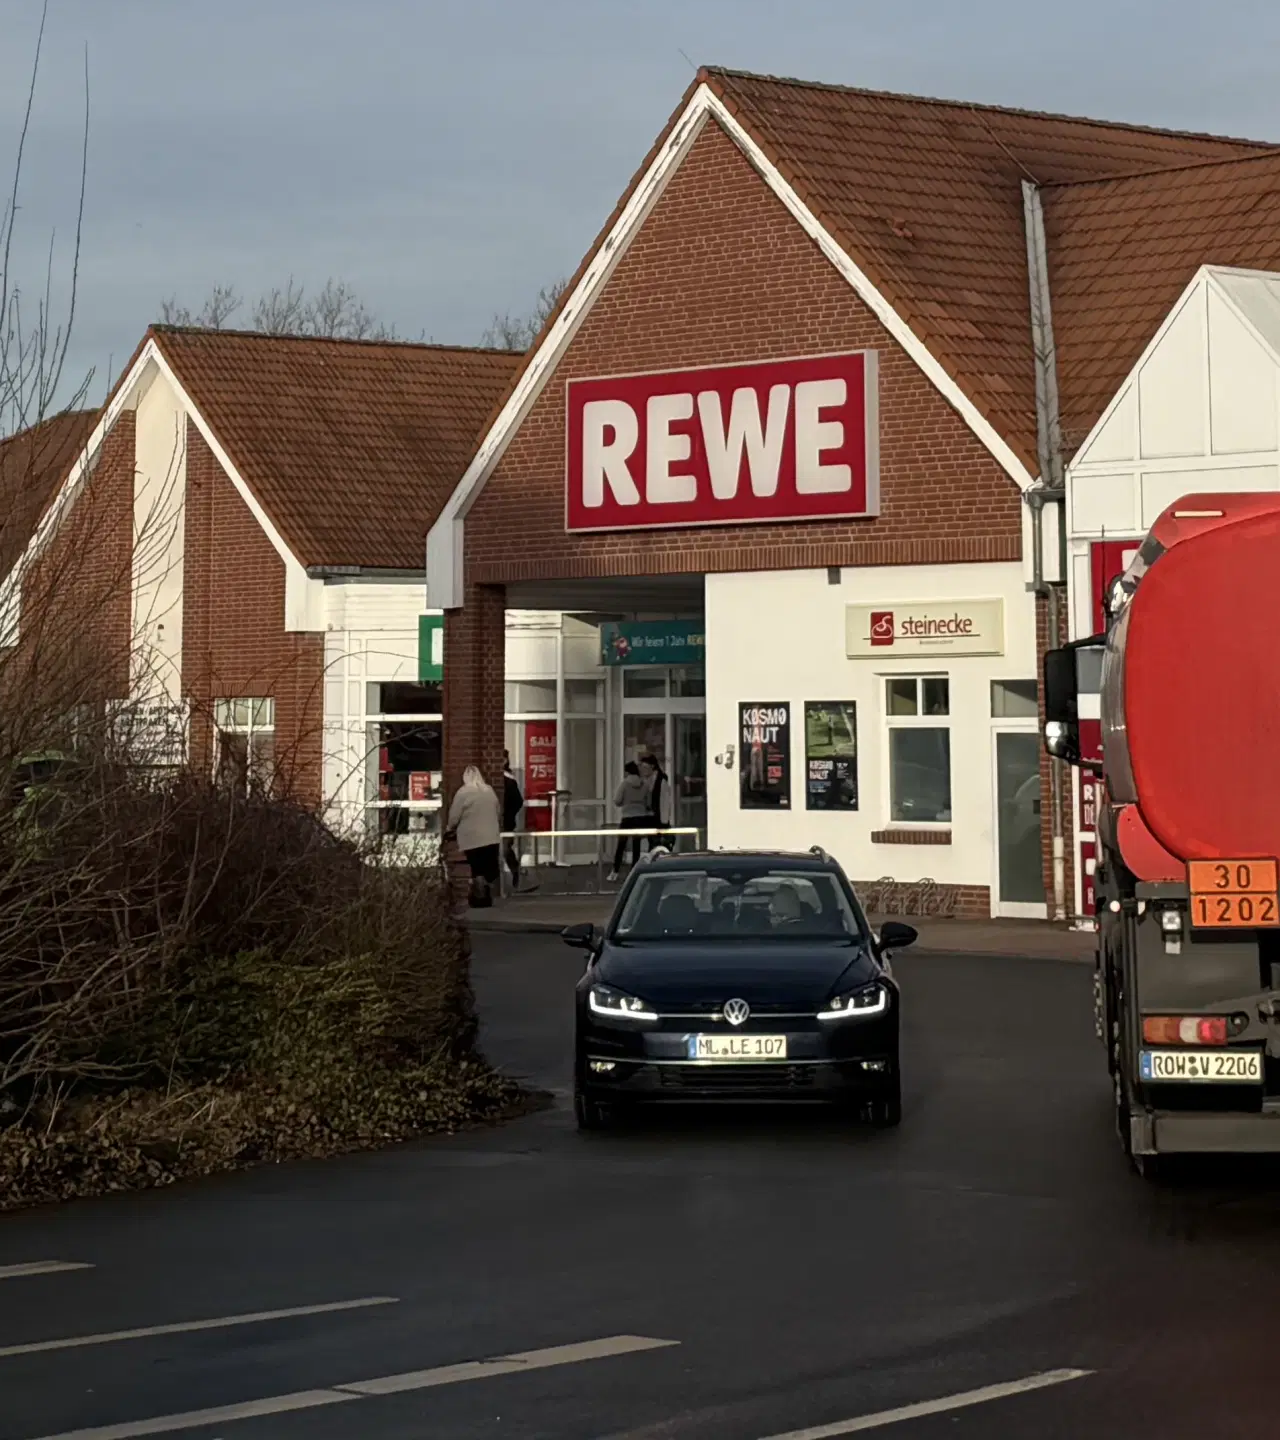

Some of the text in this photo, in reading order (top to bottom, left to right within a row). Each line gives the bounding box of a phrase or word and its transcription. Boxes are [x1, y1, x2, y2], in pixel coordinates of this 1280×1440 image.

[582, 377, 853, 509] REWE
[901, 612, 973, 635] steinecke
[742, 726, 779, 744] NAUT
[1213, 863, 1252, 890] 30
[1198, 895, 1276, 923] 1202
[698, 1038, 783, 1055] ML LE 107
[1153, 1055, 1258, 1076] ROW V 2206
